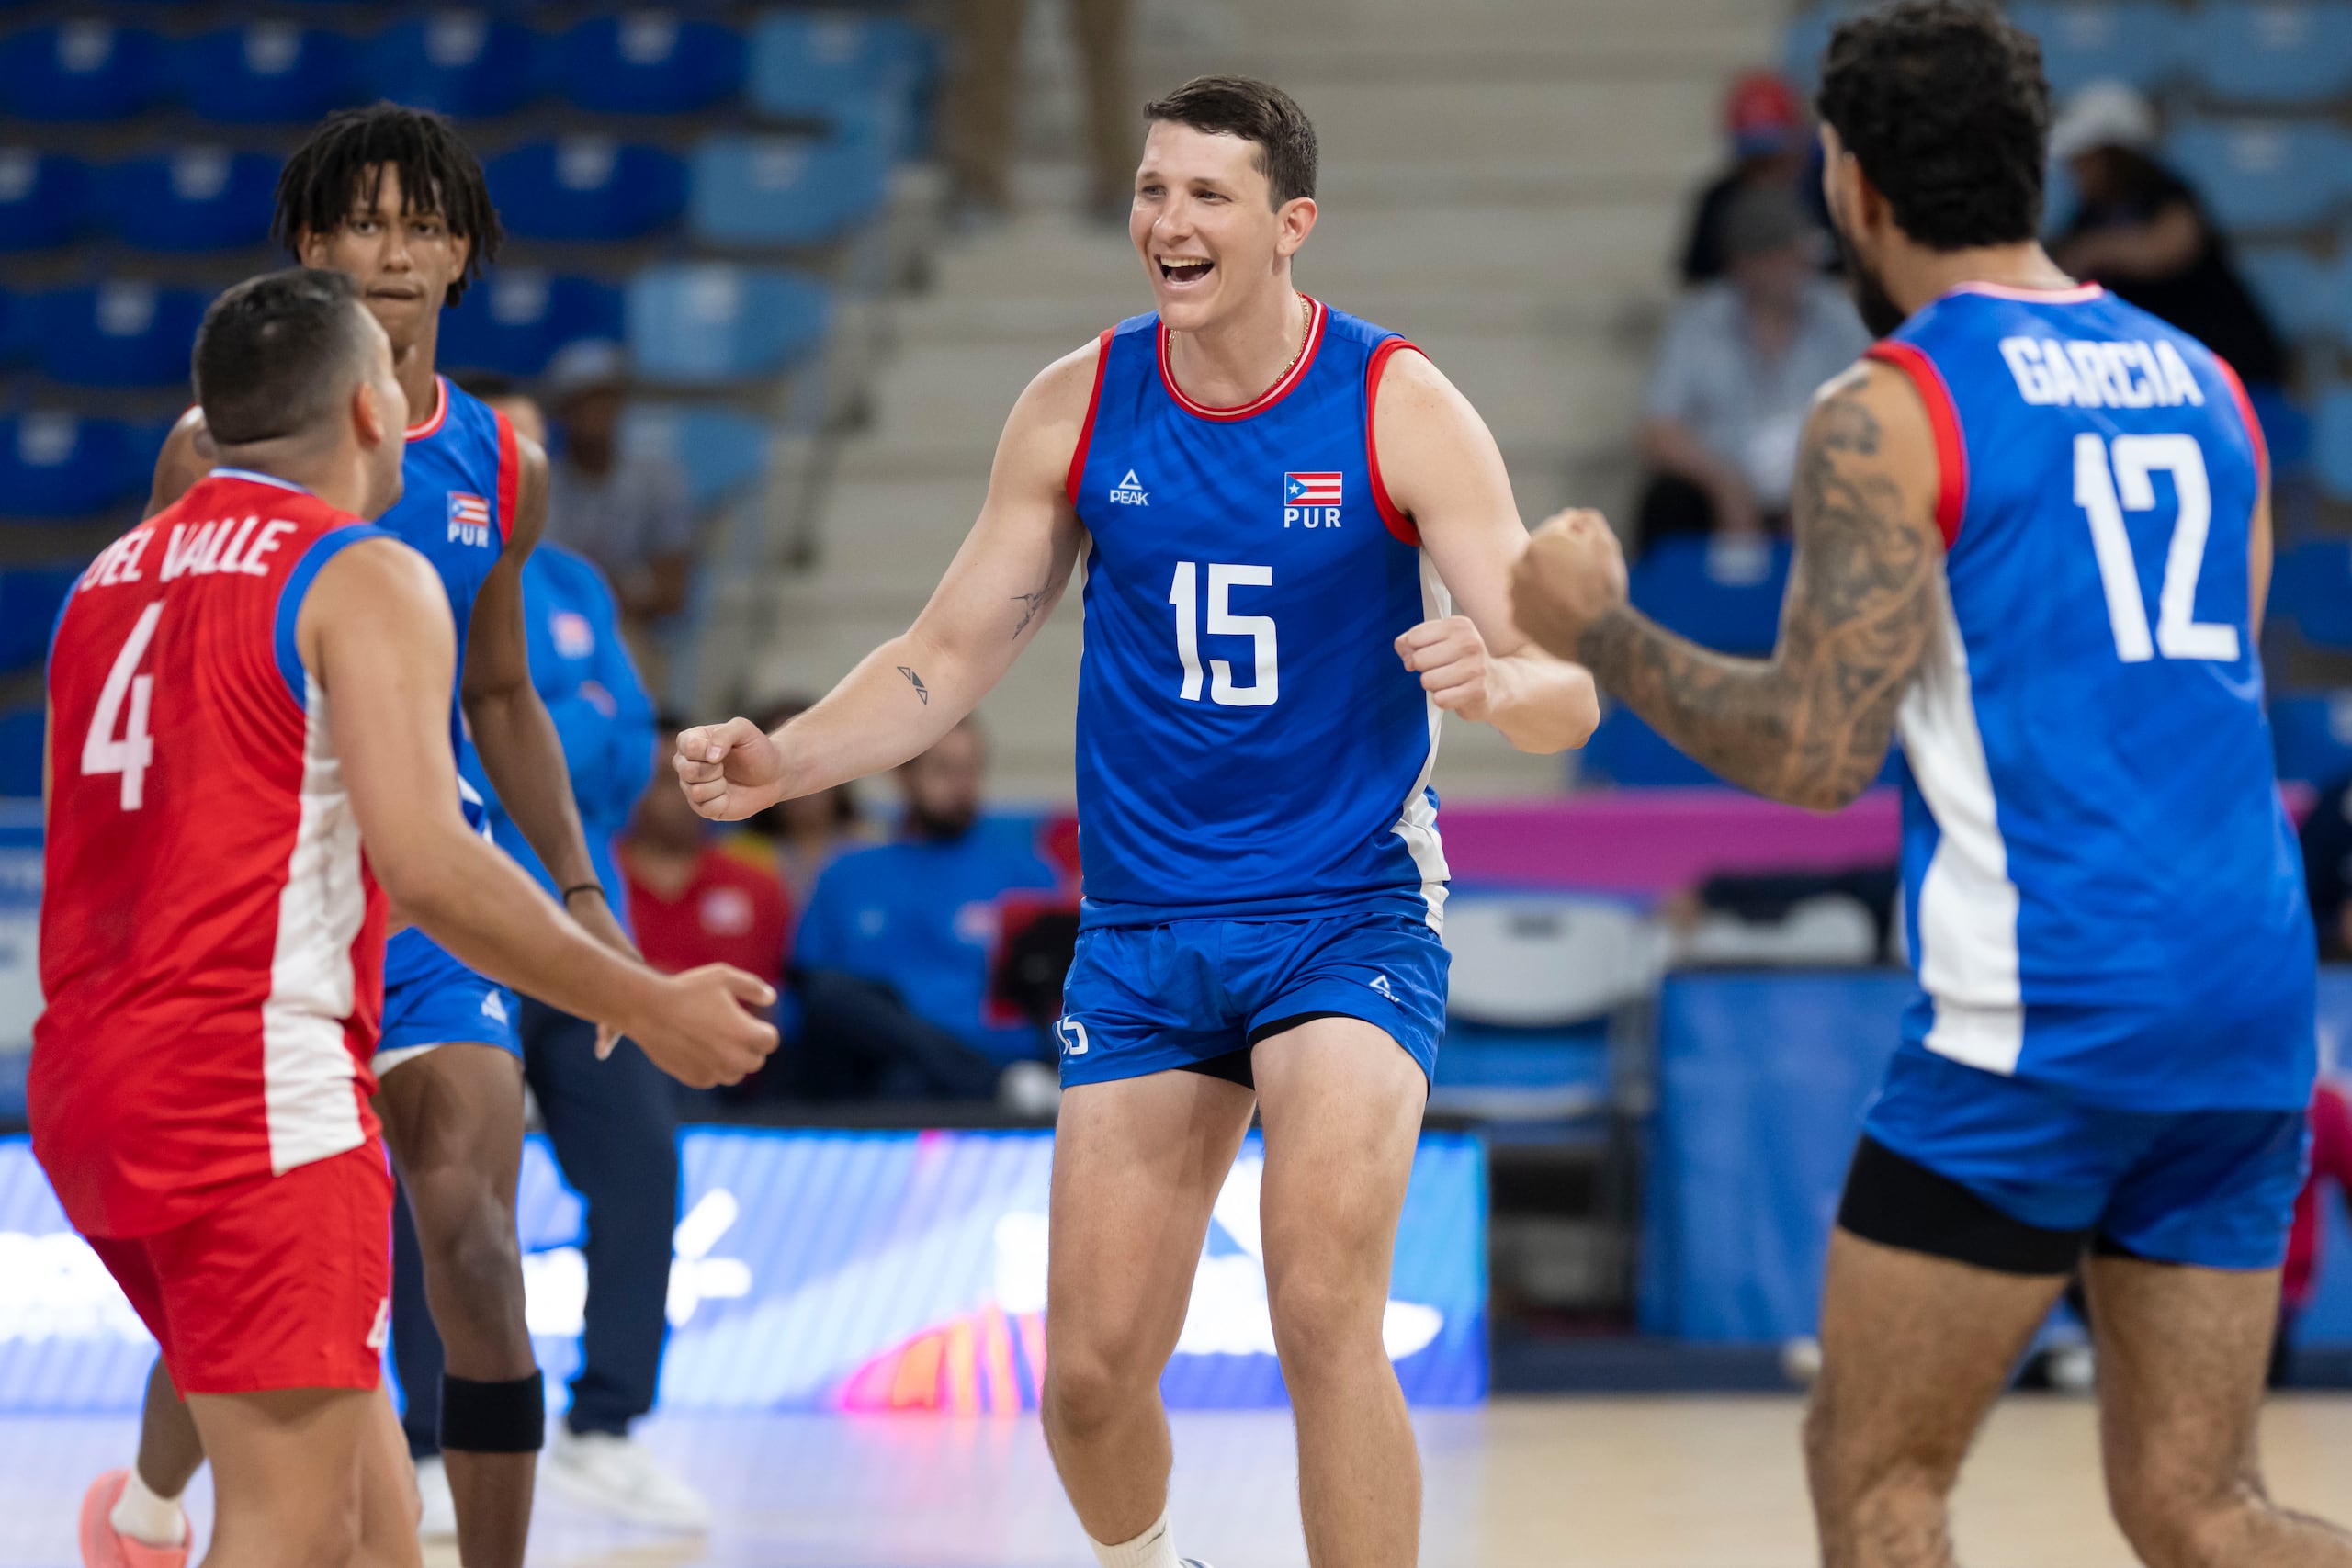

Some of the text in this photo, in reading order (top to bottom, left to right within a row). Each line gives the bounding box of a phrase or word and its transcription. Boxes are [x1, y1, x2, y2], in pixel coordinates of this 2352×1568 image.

[1999, 336, 2205, 408] GARCIA
[1110, 489, 1150, 506] PEAK
[1284, 507, 1341, 528] PUR
[159, 515, 298, 583] VALLE
[447, 521, 489, 548] PUR
[2073, 432, 2240, 662] 12
[1169, 561, 1278, 706] 15
[81, 601, 164, 810] 4
